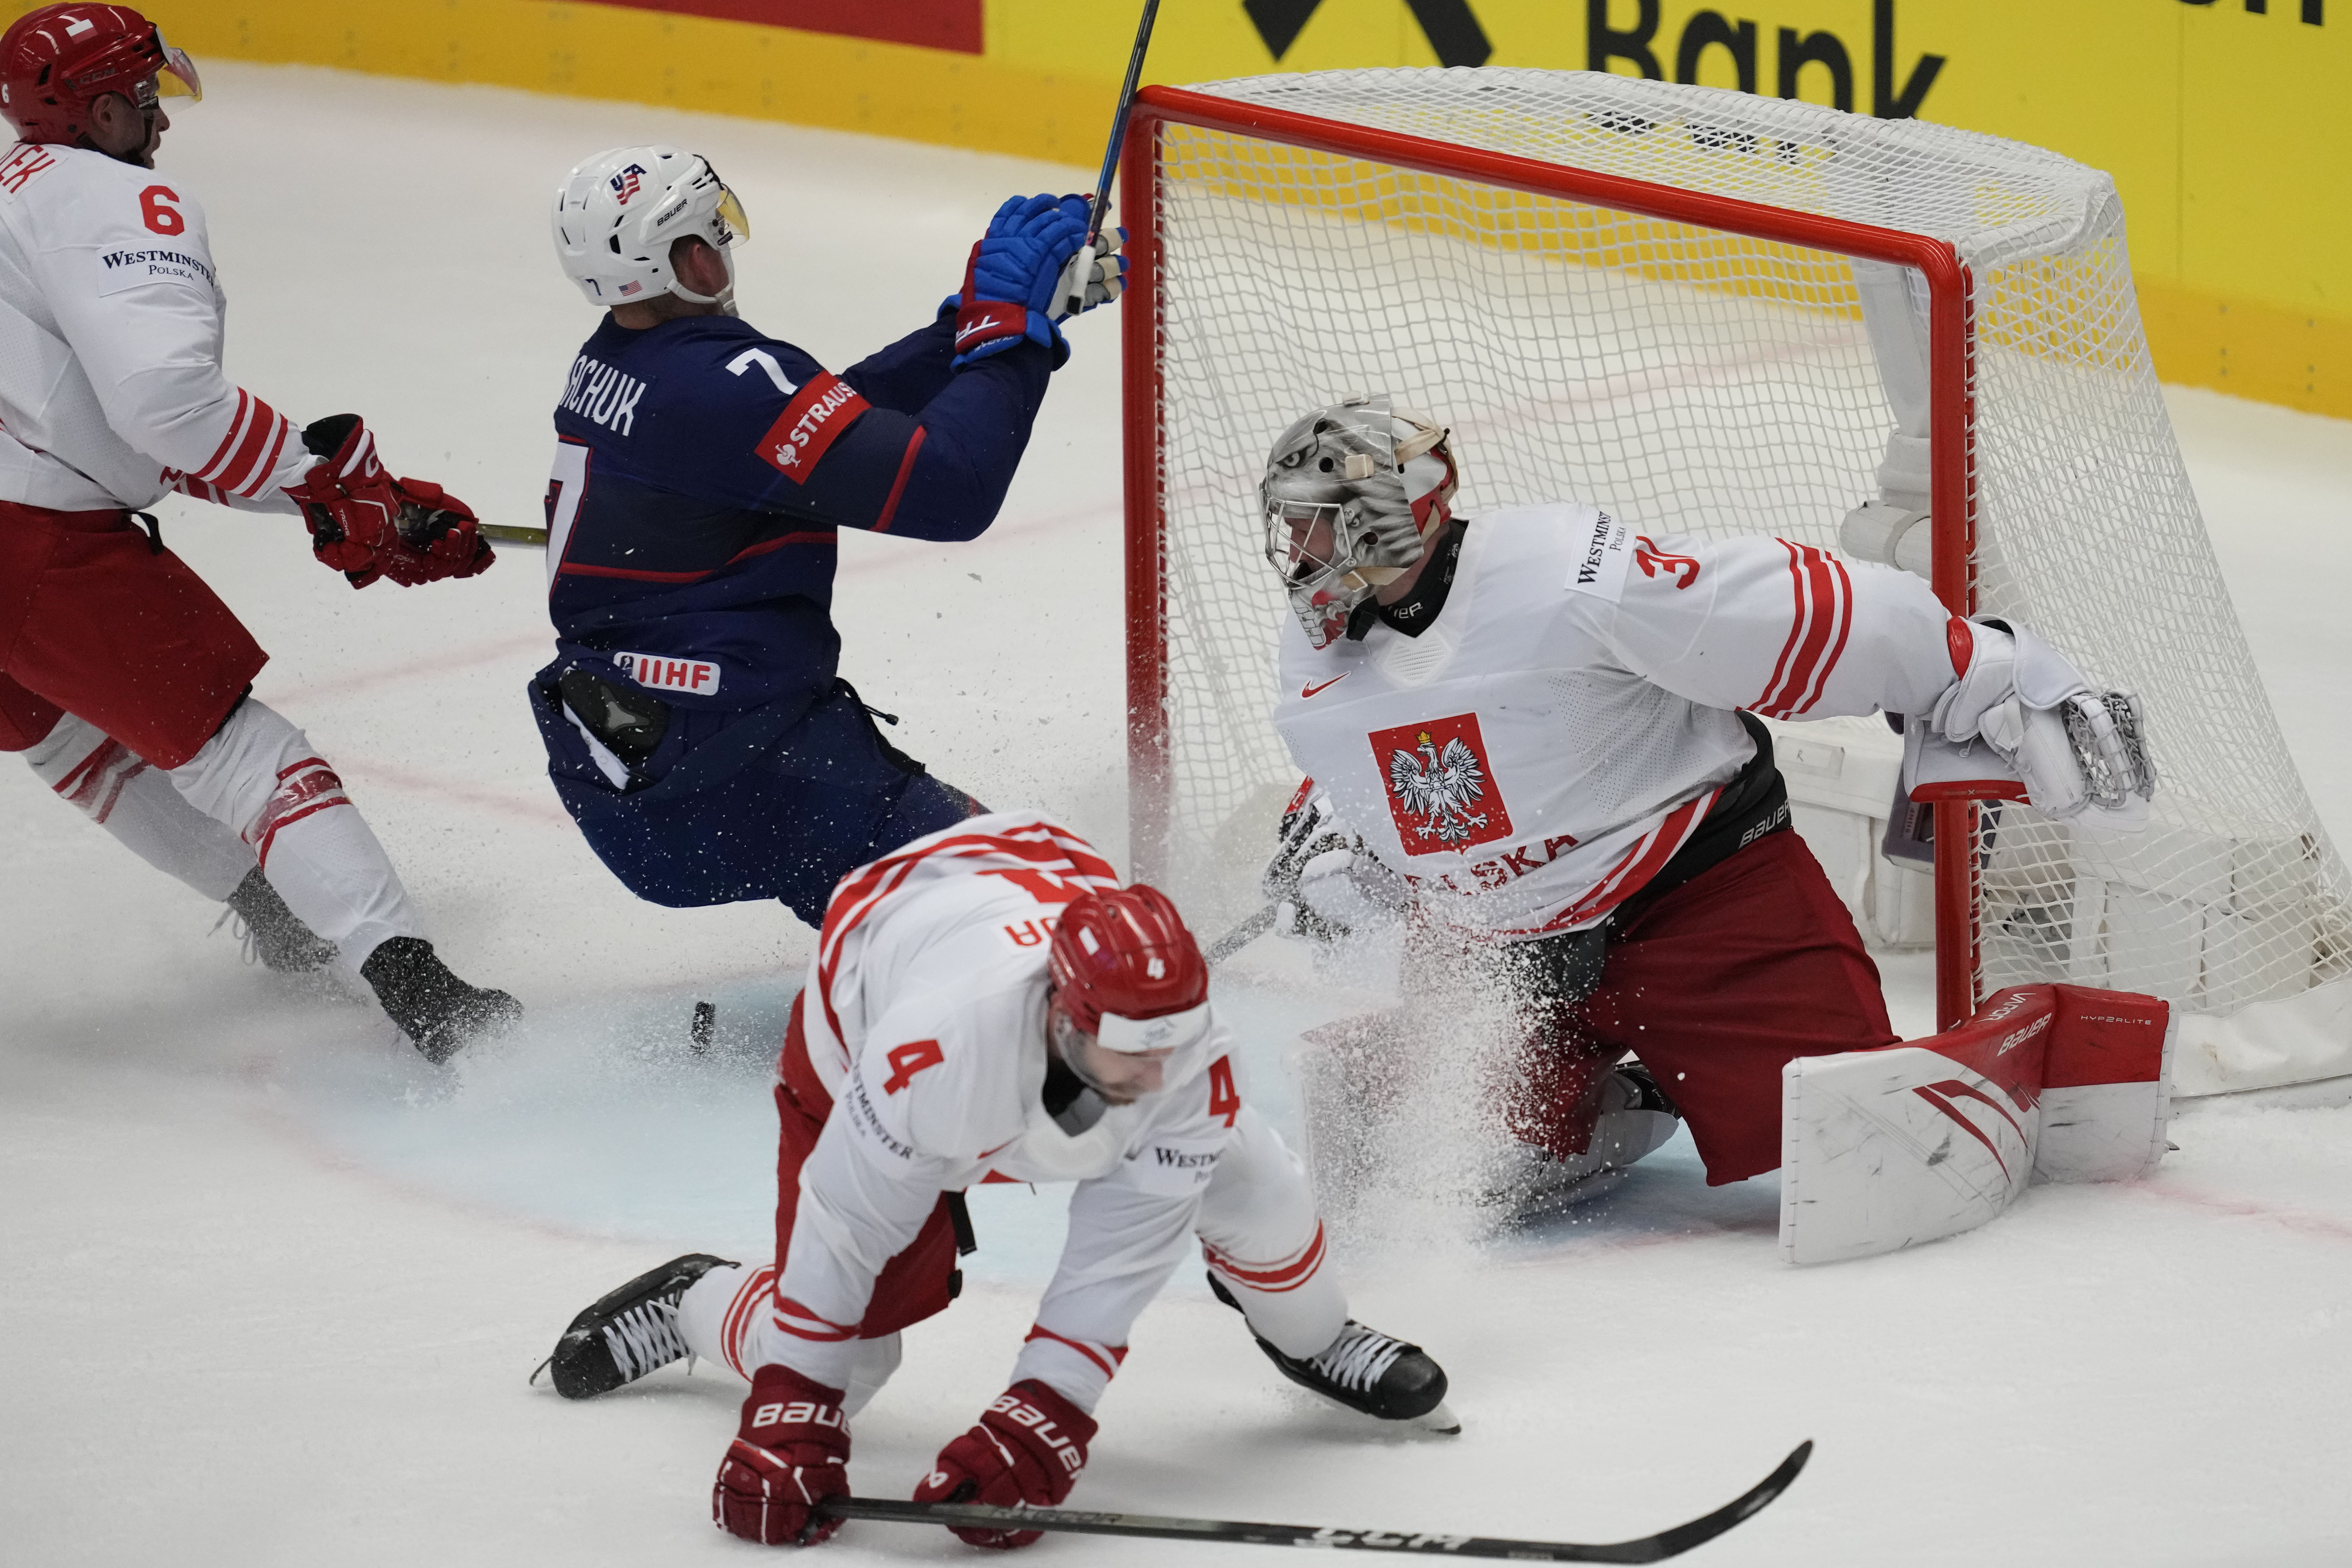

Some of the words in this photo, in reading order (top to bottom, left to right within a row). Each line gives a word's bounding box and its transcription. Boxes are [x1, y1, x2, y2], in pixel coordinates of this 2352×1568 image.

[1, 83, 10, 104] 6
[1588, 0, 1947, 143] Bank
[0, 143, 55, 194] EK
[610, 163, 647, 205] USA
[139, 185, 185, 236] 6
[657, 198, 688, 227] BAUER
[148, 265, 194, 280] POLSKA
[725, 347, 798, 395] 7
[559, 352, 647, 437] ACHUK
[339, 508, 350, 536] TACKS
[1609, 527, 1627, 551] POLSKA
[639, 658, 711, 689] IIHF
[1738, 798, 1790, 850] BAUER
[1974, 993, 2037, 1023] VAPOR
[1996, 1012, 2052, 1057] BAUER
[883, 1039, 945, 1096] 4
[1208, 1054, 1241, 1129] 4
